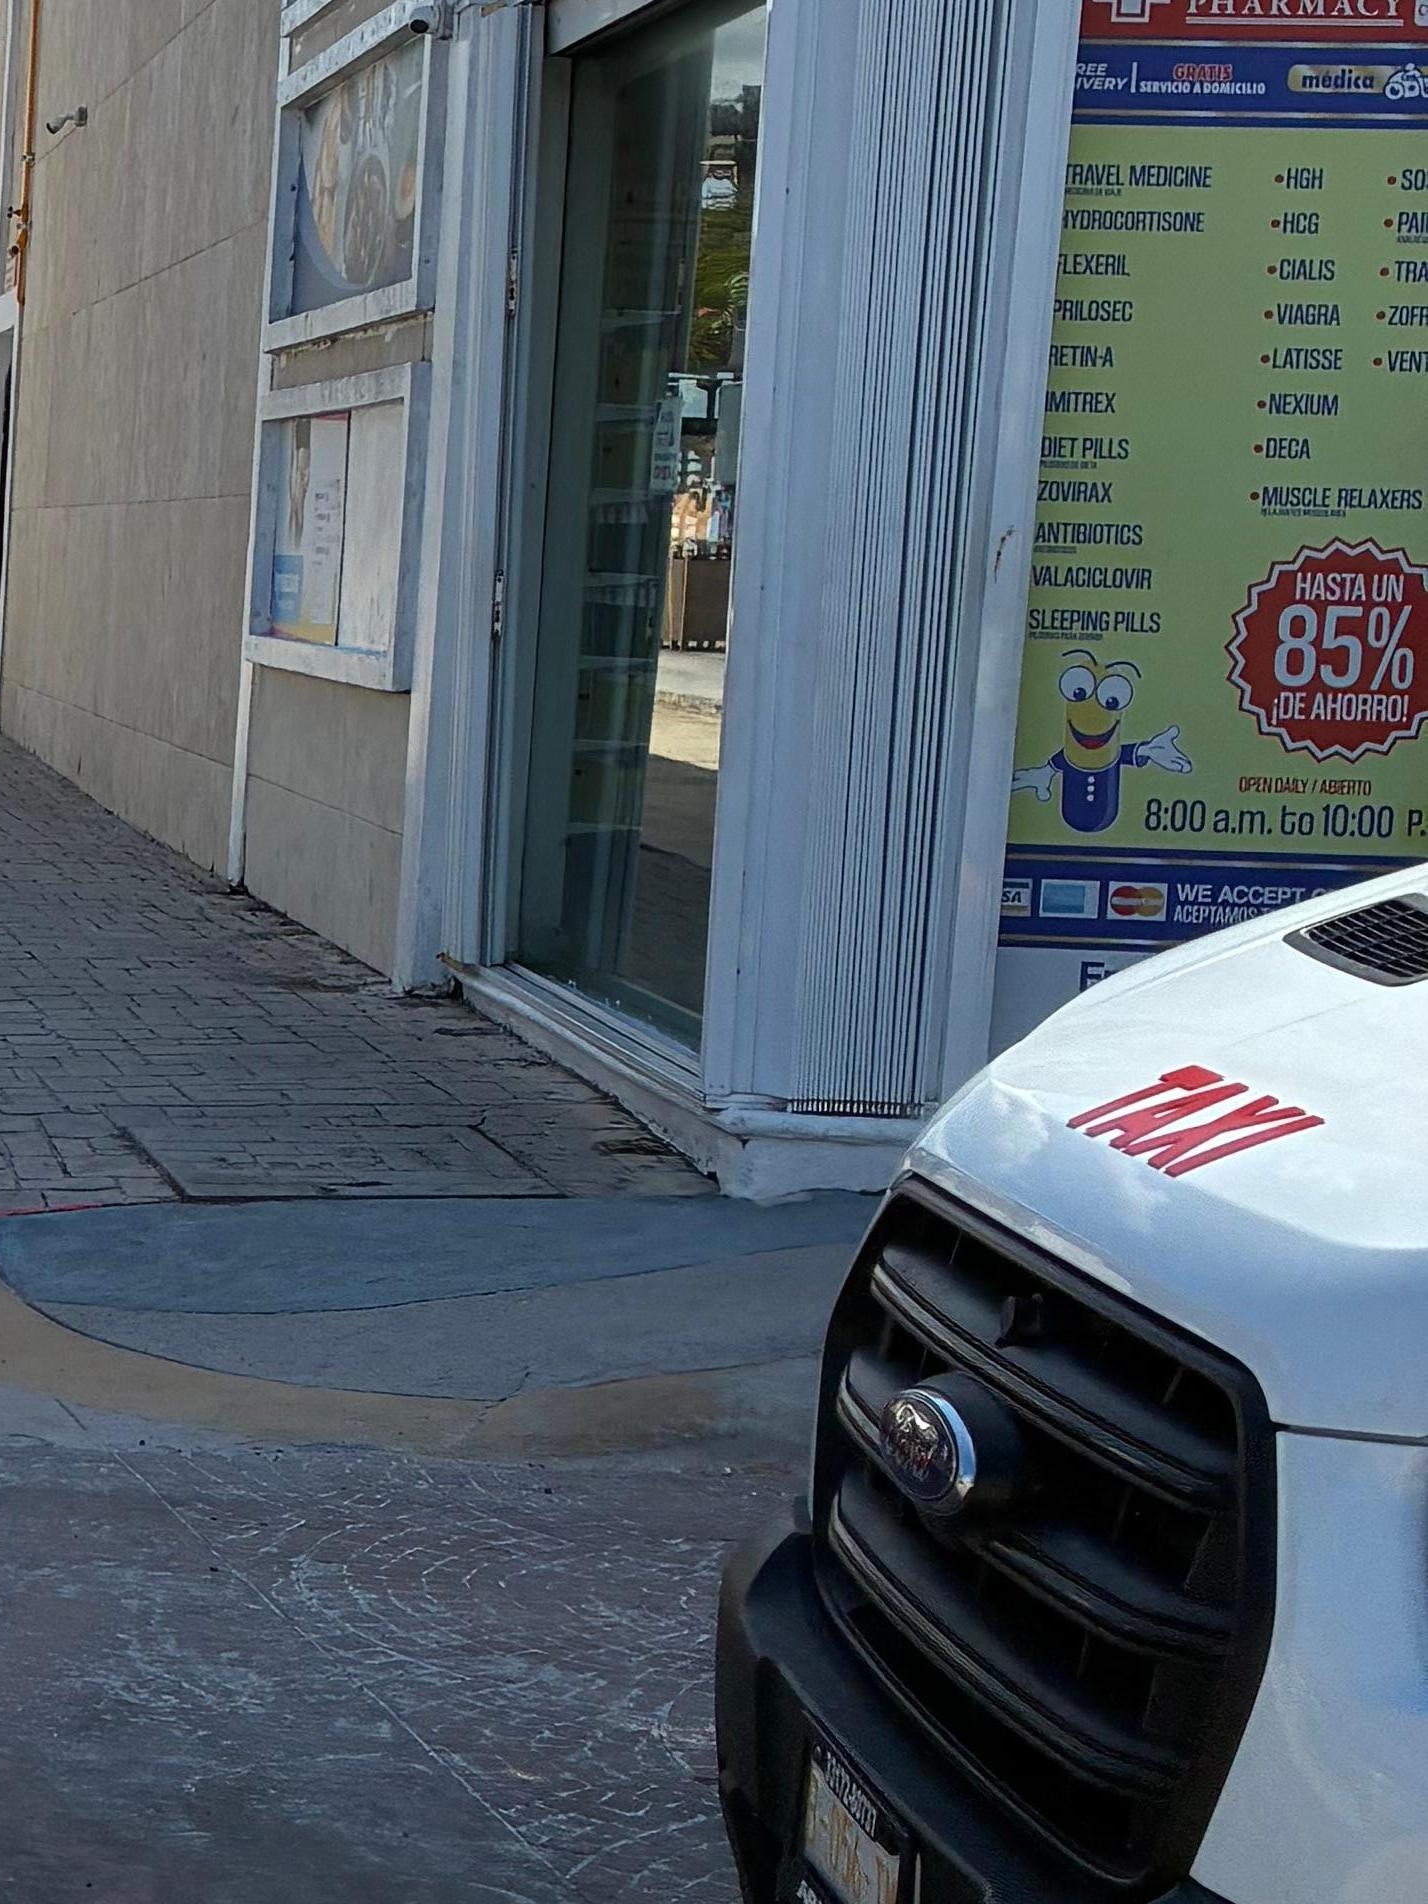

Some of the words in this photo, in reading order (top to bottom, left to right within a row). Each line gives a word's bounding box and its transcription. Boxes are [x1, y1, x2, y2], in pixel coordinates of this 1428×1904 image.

[1173, 63, 1234, 81] GRATIS
[1139, 80, 1191, 94] SERVICIO
[1202, 82, 1266, 95] DOMICILIO
[1065, 163, 1124, 186] TRAVEL
[1129, 165, 1213, 188] MEDICINE
[1286, 167, 1324, 190] HGH
[1400, 168, 1428, 191] SO
[1282, 212, 1320, 234] HCG
[1279, 258, 1336, 281] CIALIS
[1053, 299, 1133, 322] PRILOSEC
[1276, 303, 1341, 326] VIAGRA
[1049, 344, 1114, 367] RETIN-A
[1272, 347, 1343, 370] LATISSE
[1268, 393, 1339, 416] NEXIUM
[1040, 436, 1079, 458] DIET
[1082, 437, 1129, 459] PILLS
[1265, 437, 1311, 459] DECA
[1037, 480, 1113, 504] ZOVIRAX
[1261, 486, 1331, 507] MUSCLE
[1337, 488, 1423, 510] RELAXERS
[1034, 522, 1143, 545] ANTIBIOTICS
[1032, 565, 1152, 590] VALACICLOVIR
[1295, 572, 1366, 602] HASTA
[1372, 574, 1404, 603] UN
[1028, 608, 1110, 632] SLEEPING
[1114, 611, 1162, 634] PILLS
[1274, 603, 1415, 690] 85%
[1271, 691, 1307, 726] ¡DE
[1310, 692, 1409, 723] AHORRO!
[1238, 776, 1272, 794] OPEN
[1275, 777, 1309, 794] DAILY
[1319, 778, 1371, 796] ABIERTO
[1144, 798, 1207, 833] 8:00
[1213, 808, 1273, 835] a.m.
[1280, 805, 1315, 836] to
[1322, 803, 1394, 838] 10:00
[1176, 883, 1214, 902] WE
[1217, 884, 1306, 905] ACCEPT
[1066, 1064, 1325, 1178] TAXI
